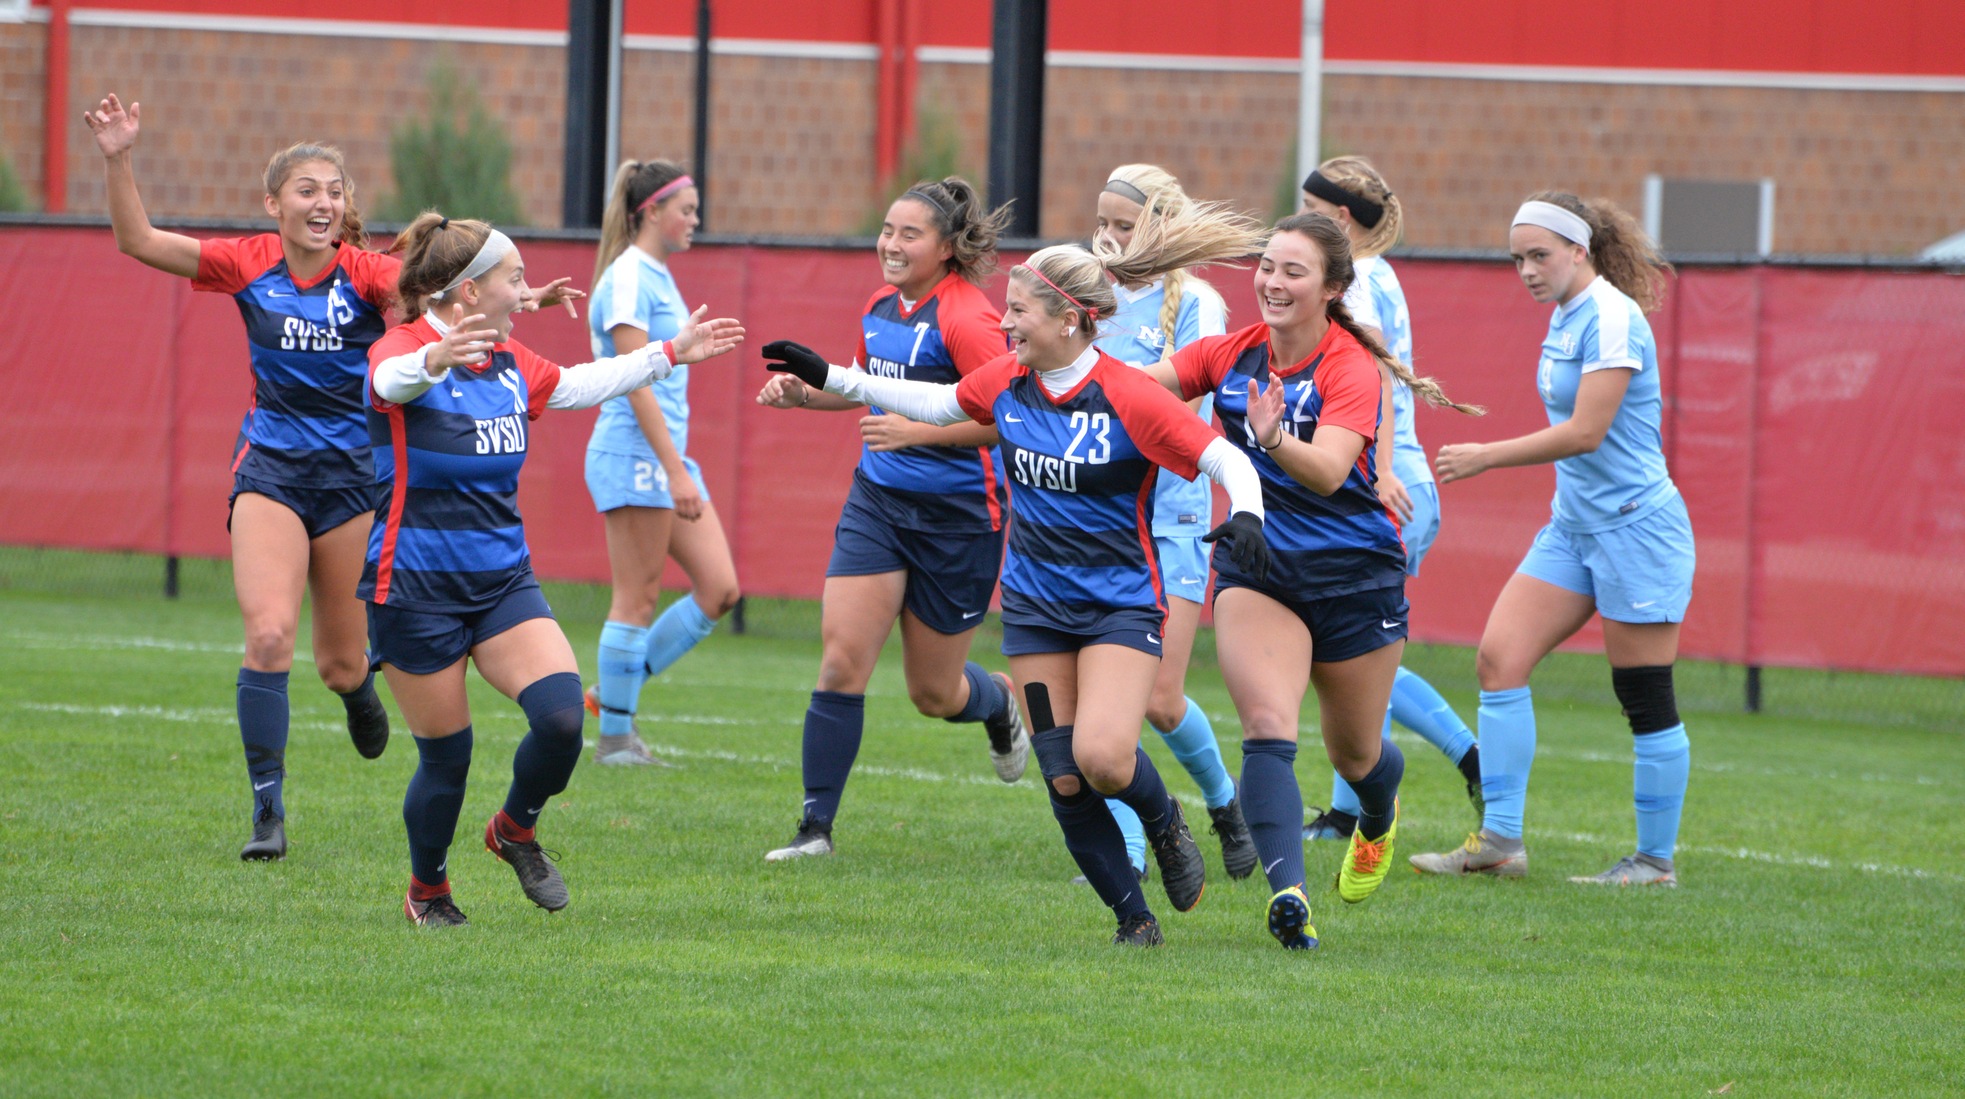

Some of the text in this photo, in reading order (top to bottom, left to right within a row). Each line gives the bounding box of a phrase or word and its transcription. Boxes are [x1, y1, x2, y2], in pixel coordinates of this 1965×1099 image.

[281, 316, 343, 352] SVSU
[909, 322, 930, 367] 7
[474, 414, 526, 455] SVSU
[1063, 411, 1111, 465] 23
[1014, 447, 1078, 493] SVSU
